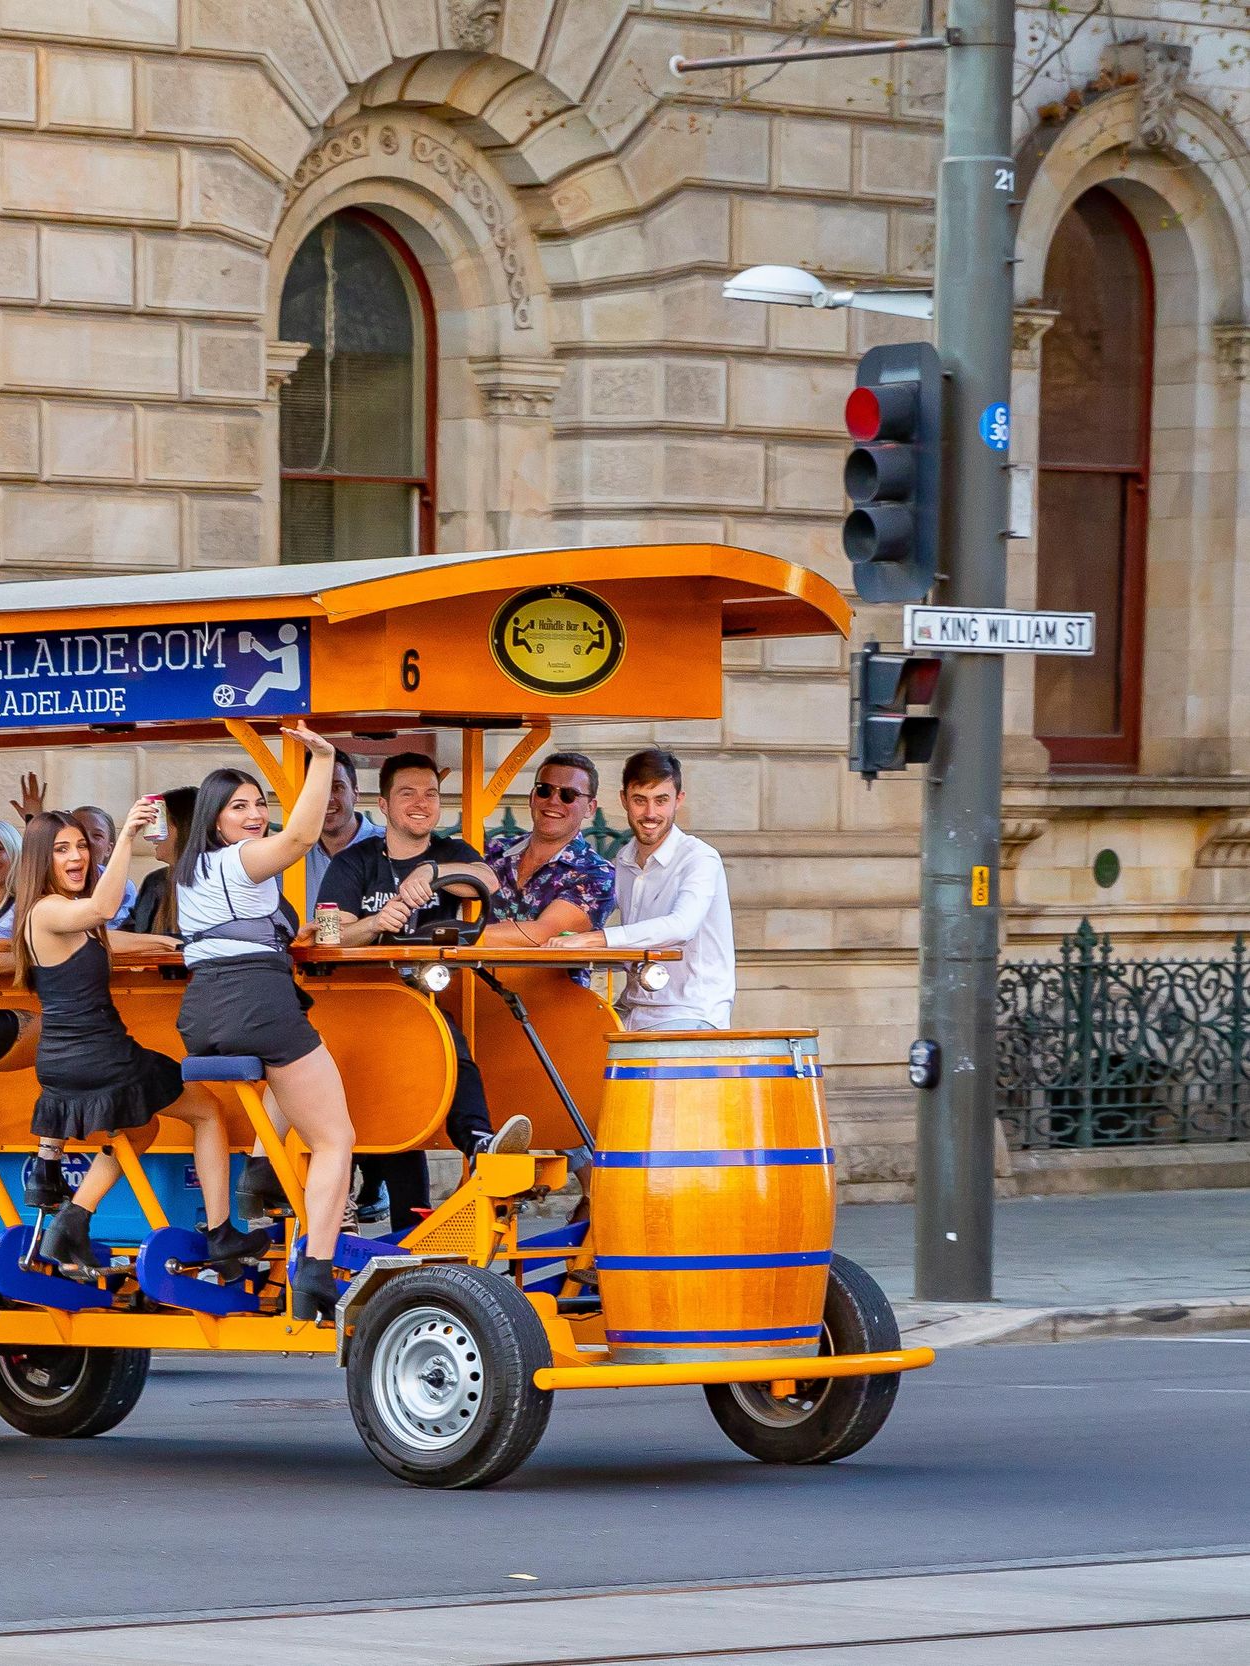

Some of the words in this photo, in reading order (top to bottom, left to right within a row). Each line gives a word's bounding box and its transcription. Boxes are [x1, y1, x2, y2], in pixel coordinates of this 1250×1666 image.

[994, 168, 1015, 192] 21
[994, 407, 1007, 424] G
[538, 619, 566, 631] Handle
[566, 621, 580, 631] Bar
[940, 616, 979, 642] KING
[987, 619, 1057, 645] WILLIAM
[1065, 622, 1086, 646] ST
[401, 648, 420, 692] 6
